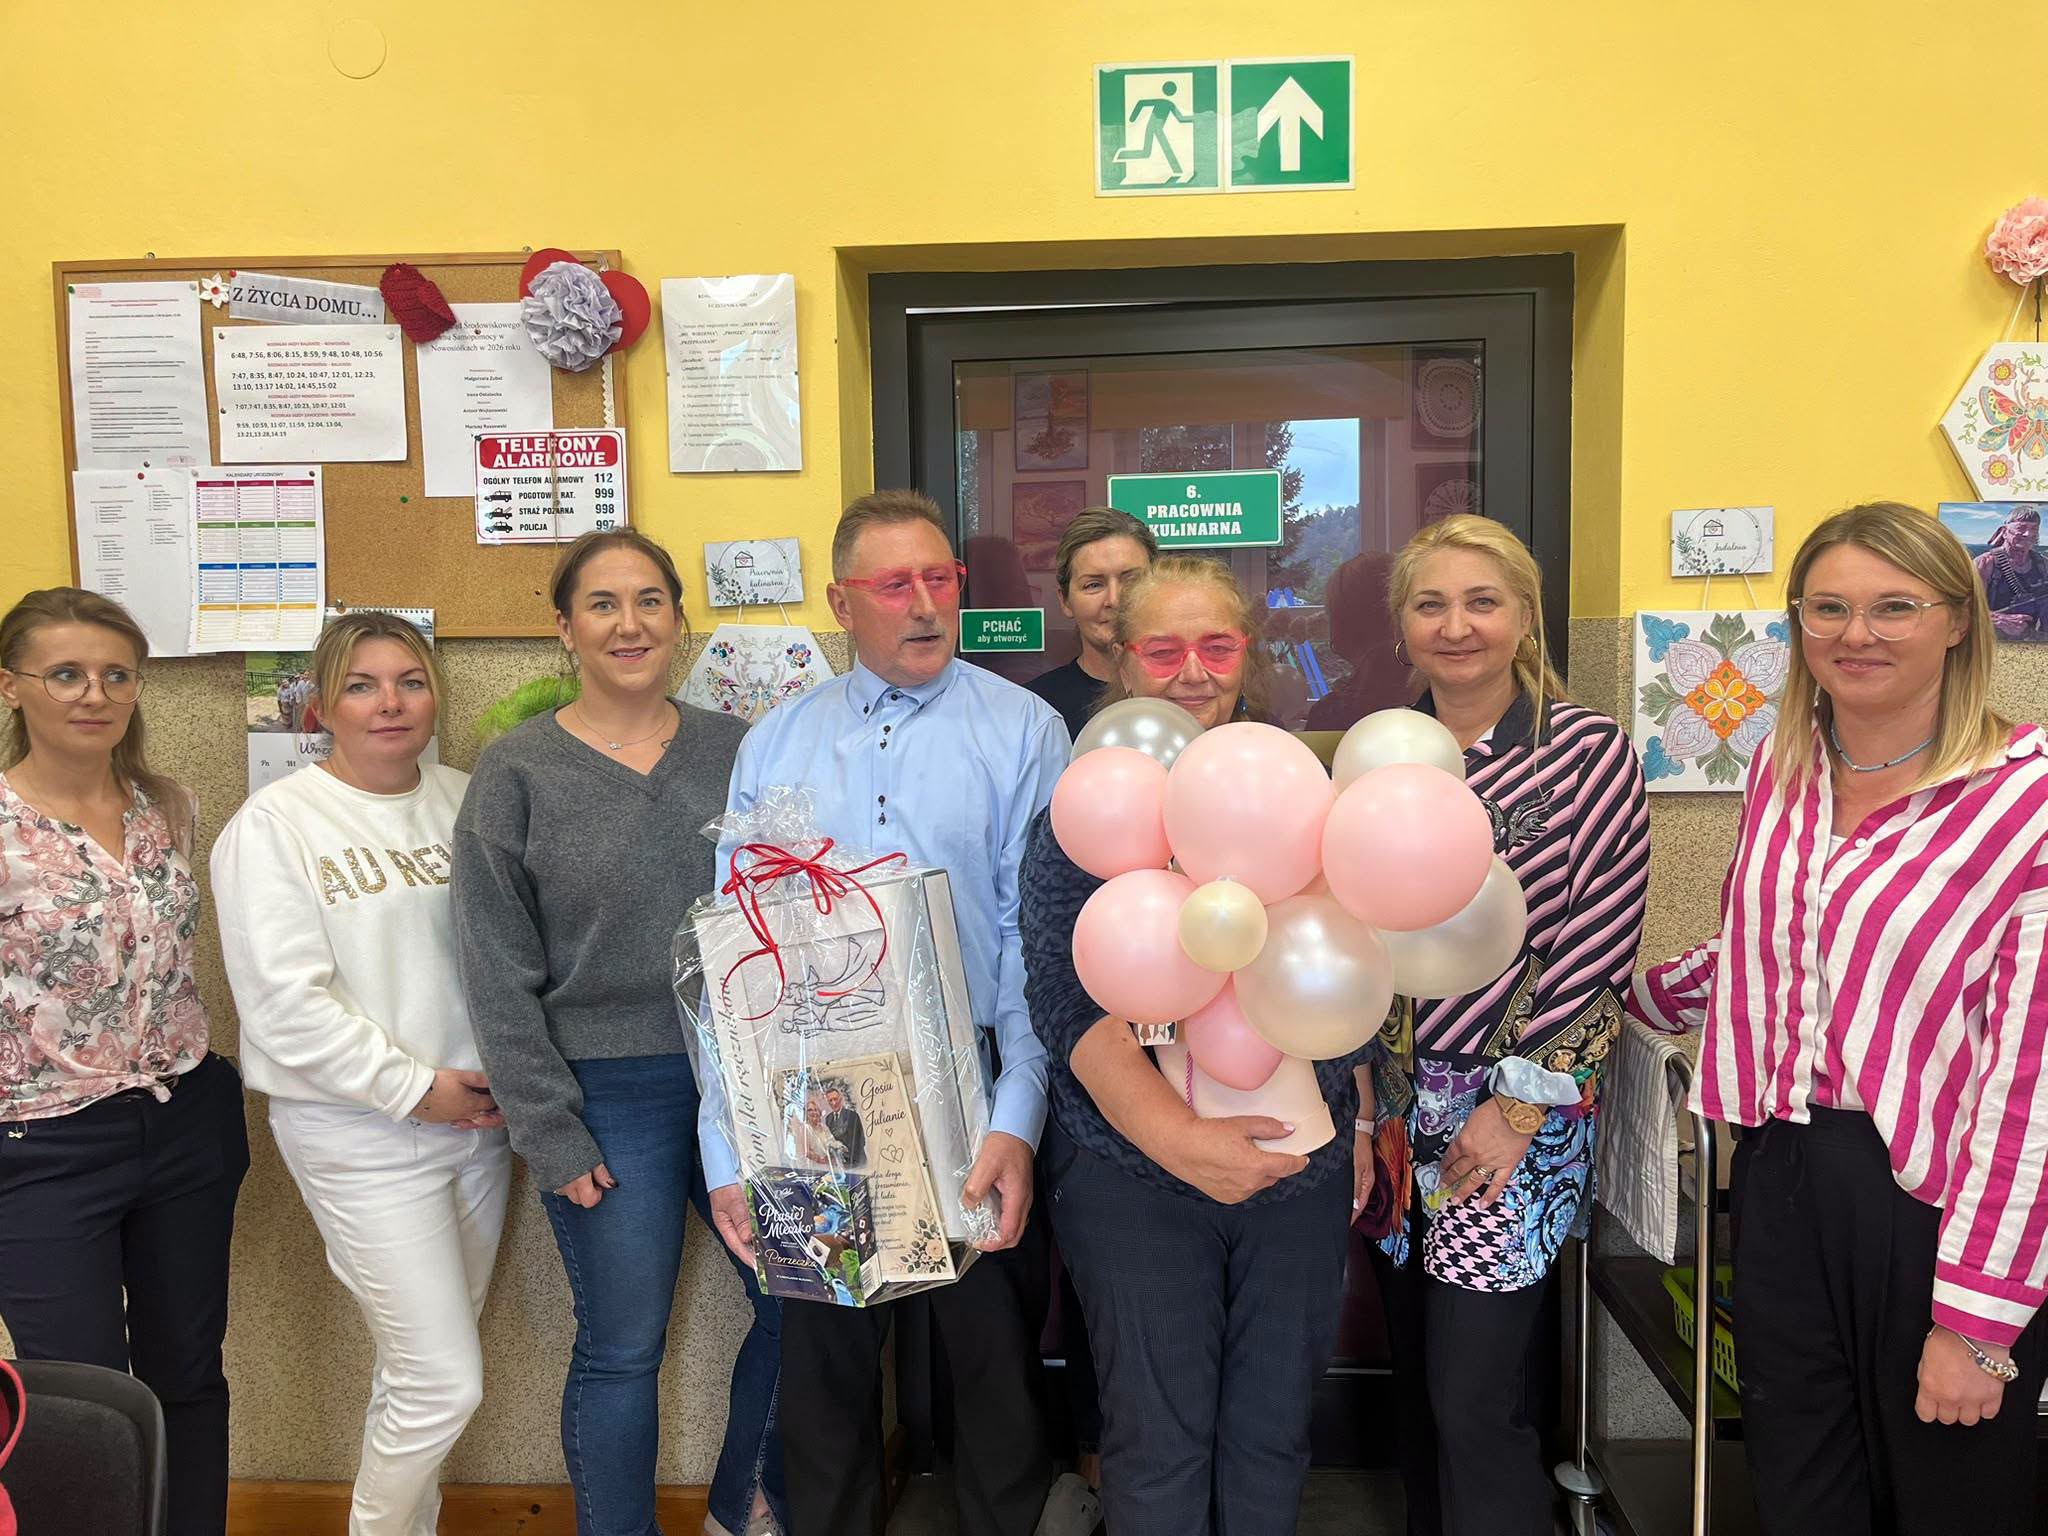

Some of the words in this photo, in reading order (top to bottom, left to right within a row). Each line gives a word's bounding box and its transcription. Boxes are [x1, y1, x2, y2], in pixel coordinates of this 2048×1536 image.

[233, 287, 243, 302] Z
[247, 285, 302, 309] ŻYCIA
[304, 295, 377, 319] DOMU...
[364, 350, 383, 358] 10:56
[505, 343, 521, 351] roku
[496, 436, 601, 453] TELEFONY
[492, 451, 606, 468] ALARMOWE
[513, 476, 543, 485] TELEFON
[544, 475, 585, 484] ALRMOWY
[594, 472, 614, 483] 112
[560, 491, 577, 499] RAT.
[594, 487, 615, 499] 999
[1185, 485, 1202, 499] 6.
[519, 505, 541, 515] STRAŻ
[595, 503, 615, 514] 998
[1147, 502, 1243, 519] PRACOWNIA
[519, 523, 548, 532] POLICJA
[595, 519, 615, 531] 997
[1148, 521, 1242, 537] KULINARNA
[982, 616, 1022, 633] PCHAĆ
[977, 636, 991, 644] aby
[993, 633, 1027, 644] otworzyć
[319, 846, 388, 906] AU
[860, 1077, 893, 1111] Gosiu
